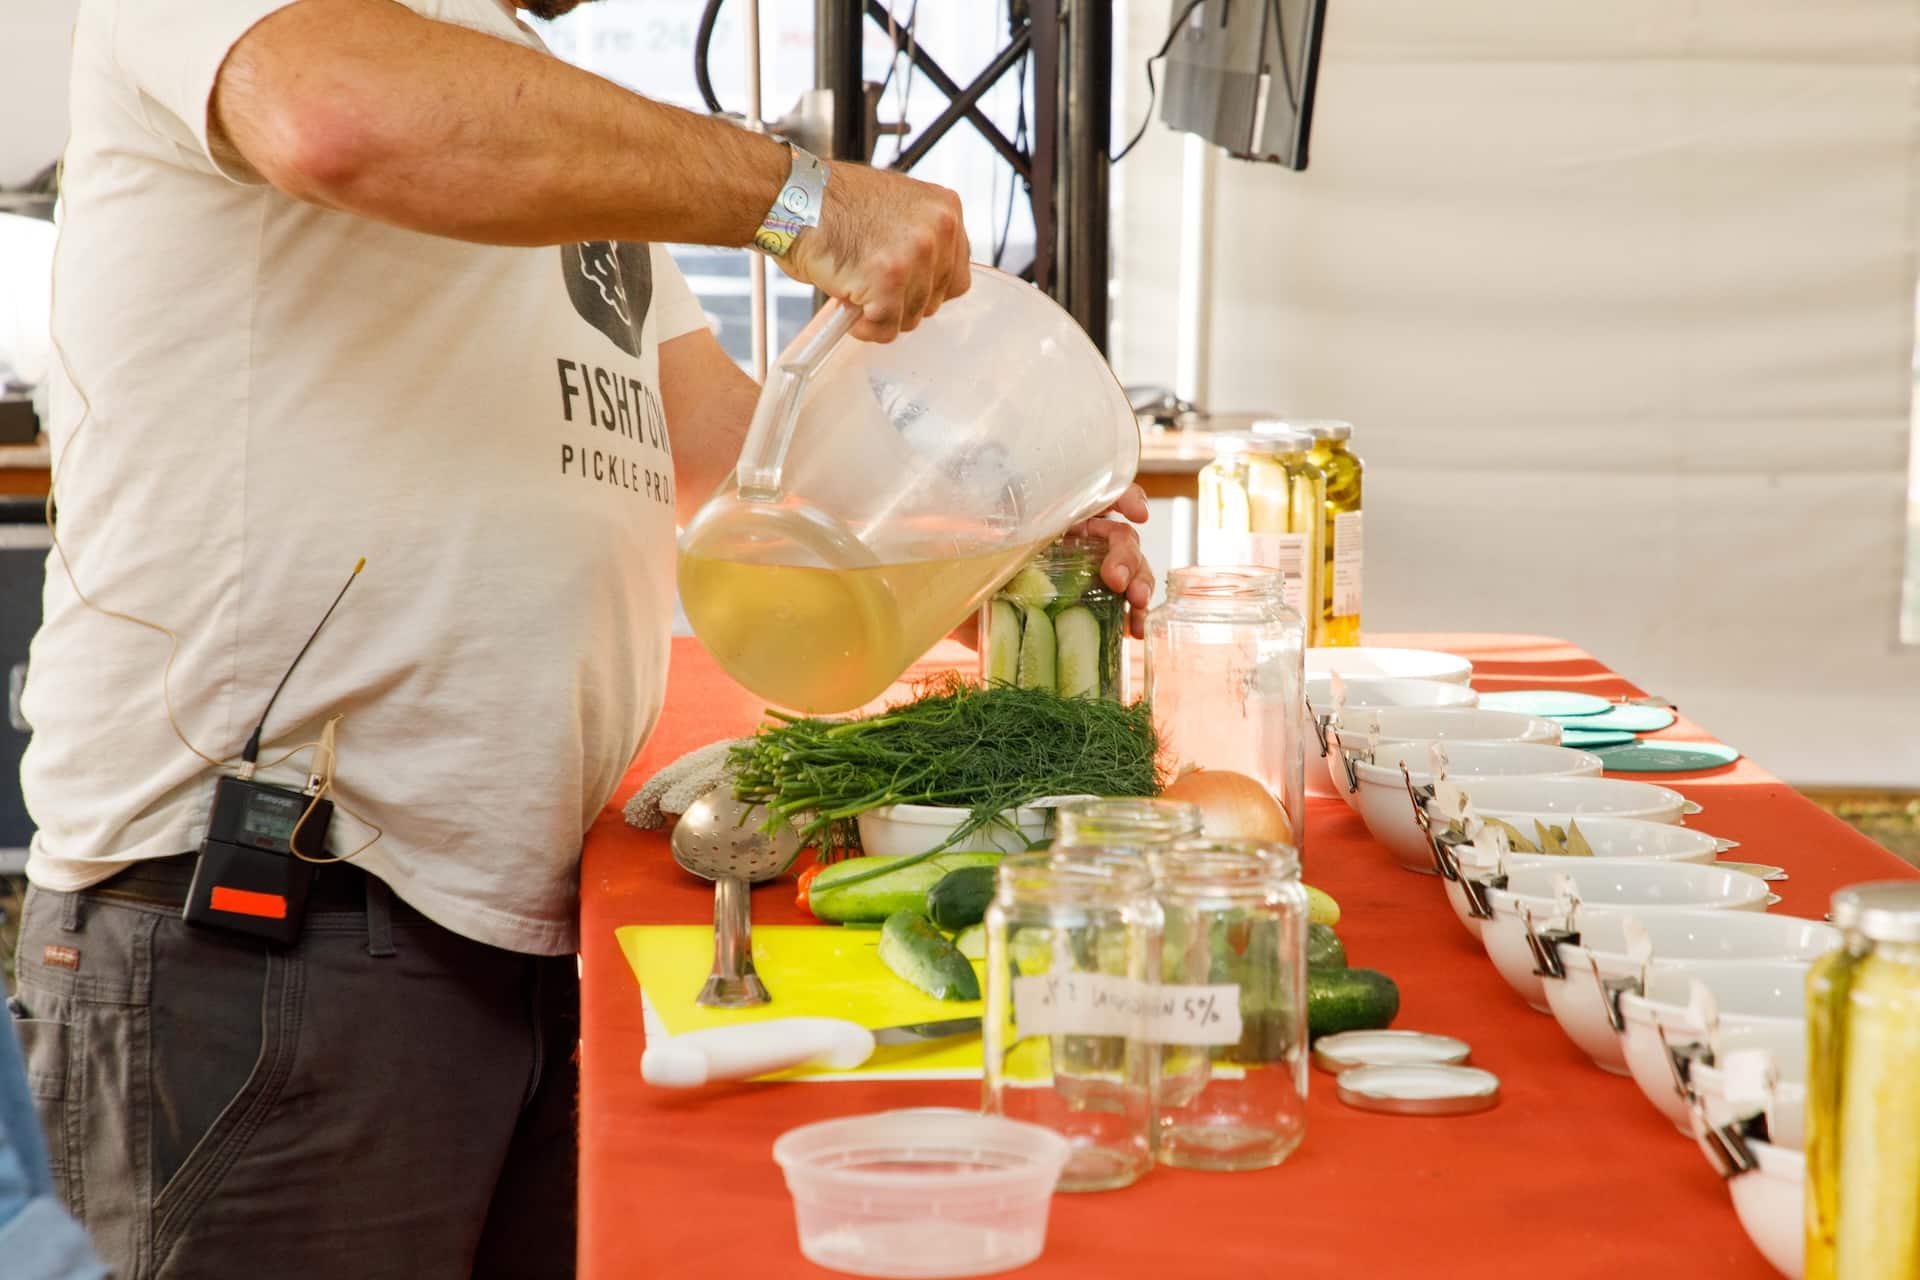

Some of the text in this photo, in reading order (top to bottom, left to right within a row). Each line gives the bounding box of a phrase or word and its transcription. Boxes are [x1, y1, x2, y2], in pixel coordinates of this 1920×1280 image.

[561, 443, 674, 507] PICKLE PRO
[1184, 994, 1221, 1027] 5%
